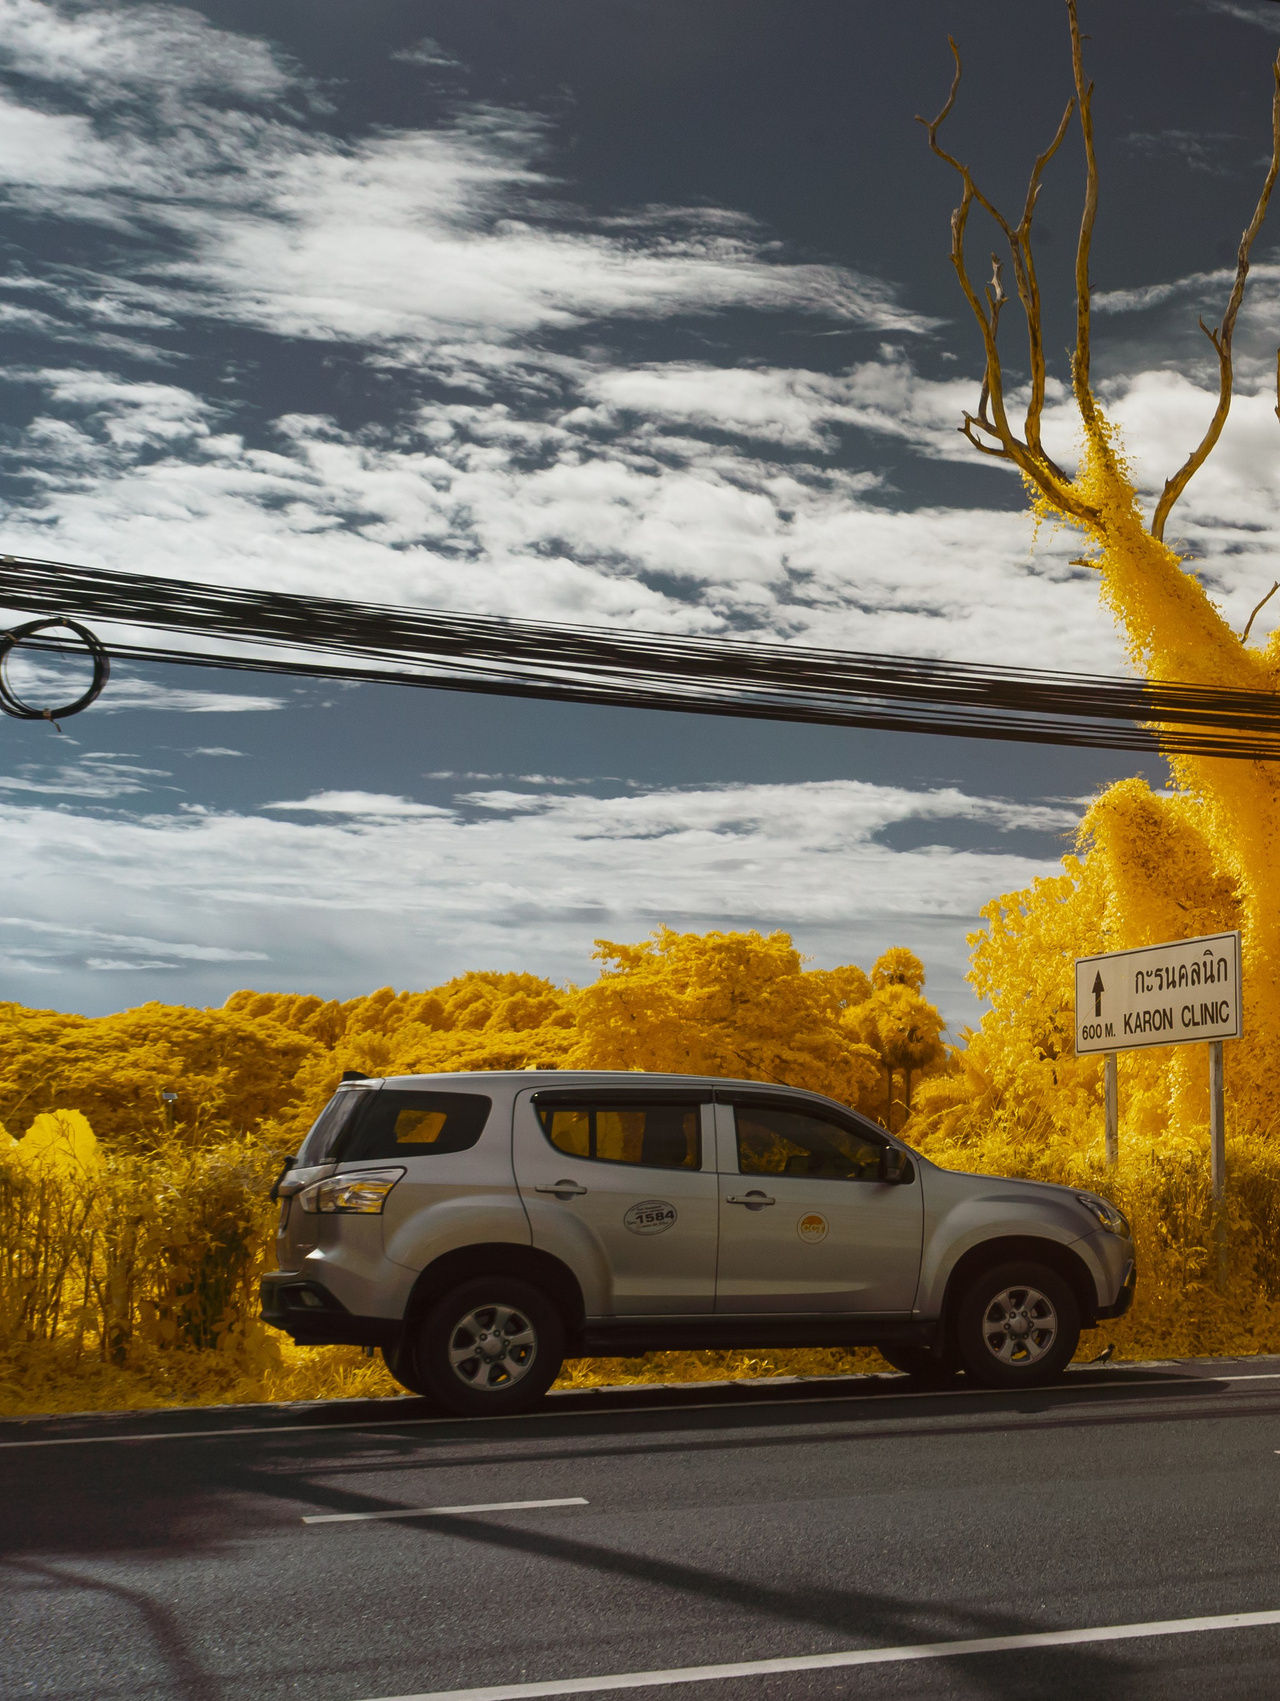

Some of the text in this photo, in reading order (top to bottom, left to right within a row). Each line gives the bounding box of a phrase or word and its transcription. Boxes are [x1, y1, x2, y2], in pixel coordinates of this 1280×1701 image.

[1123, 1000, 1230, 1035] KARON CLINIC
[1082, 1022, 1116, 1040] 600 M.
[635, 1210, 675, 1224] 1584
